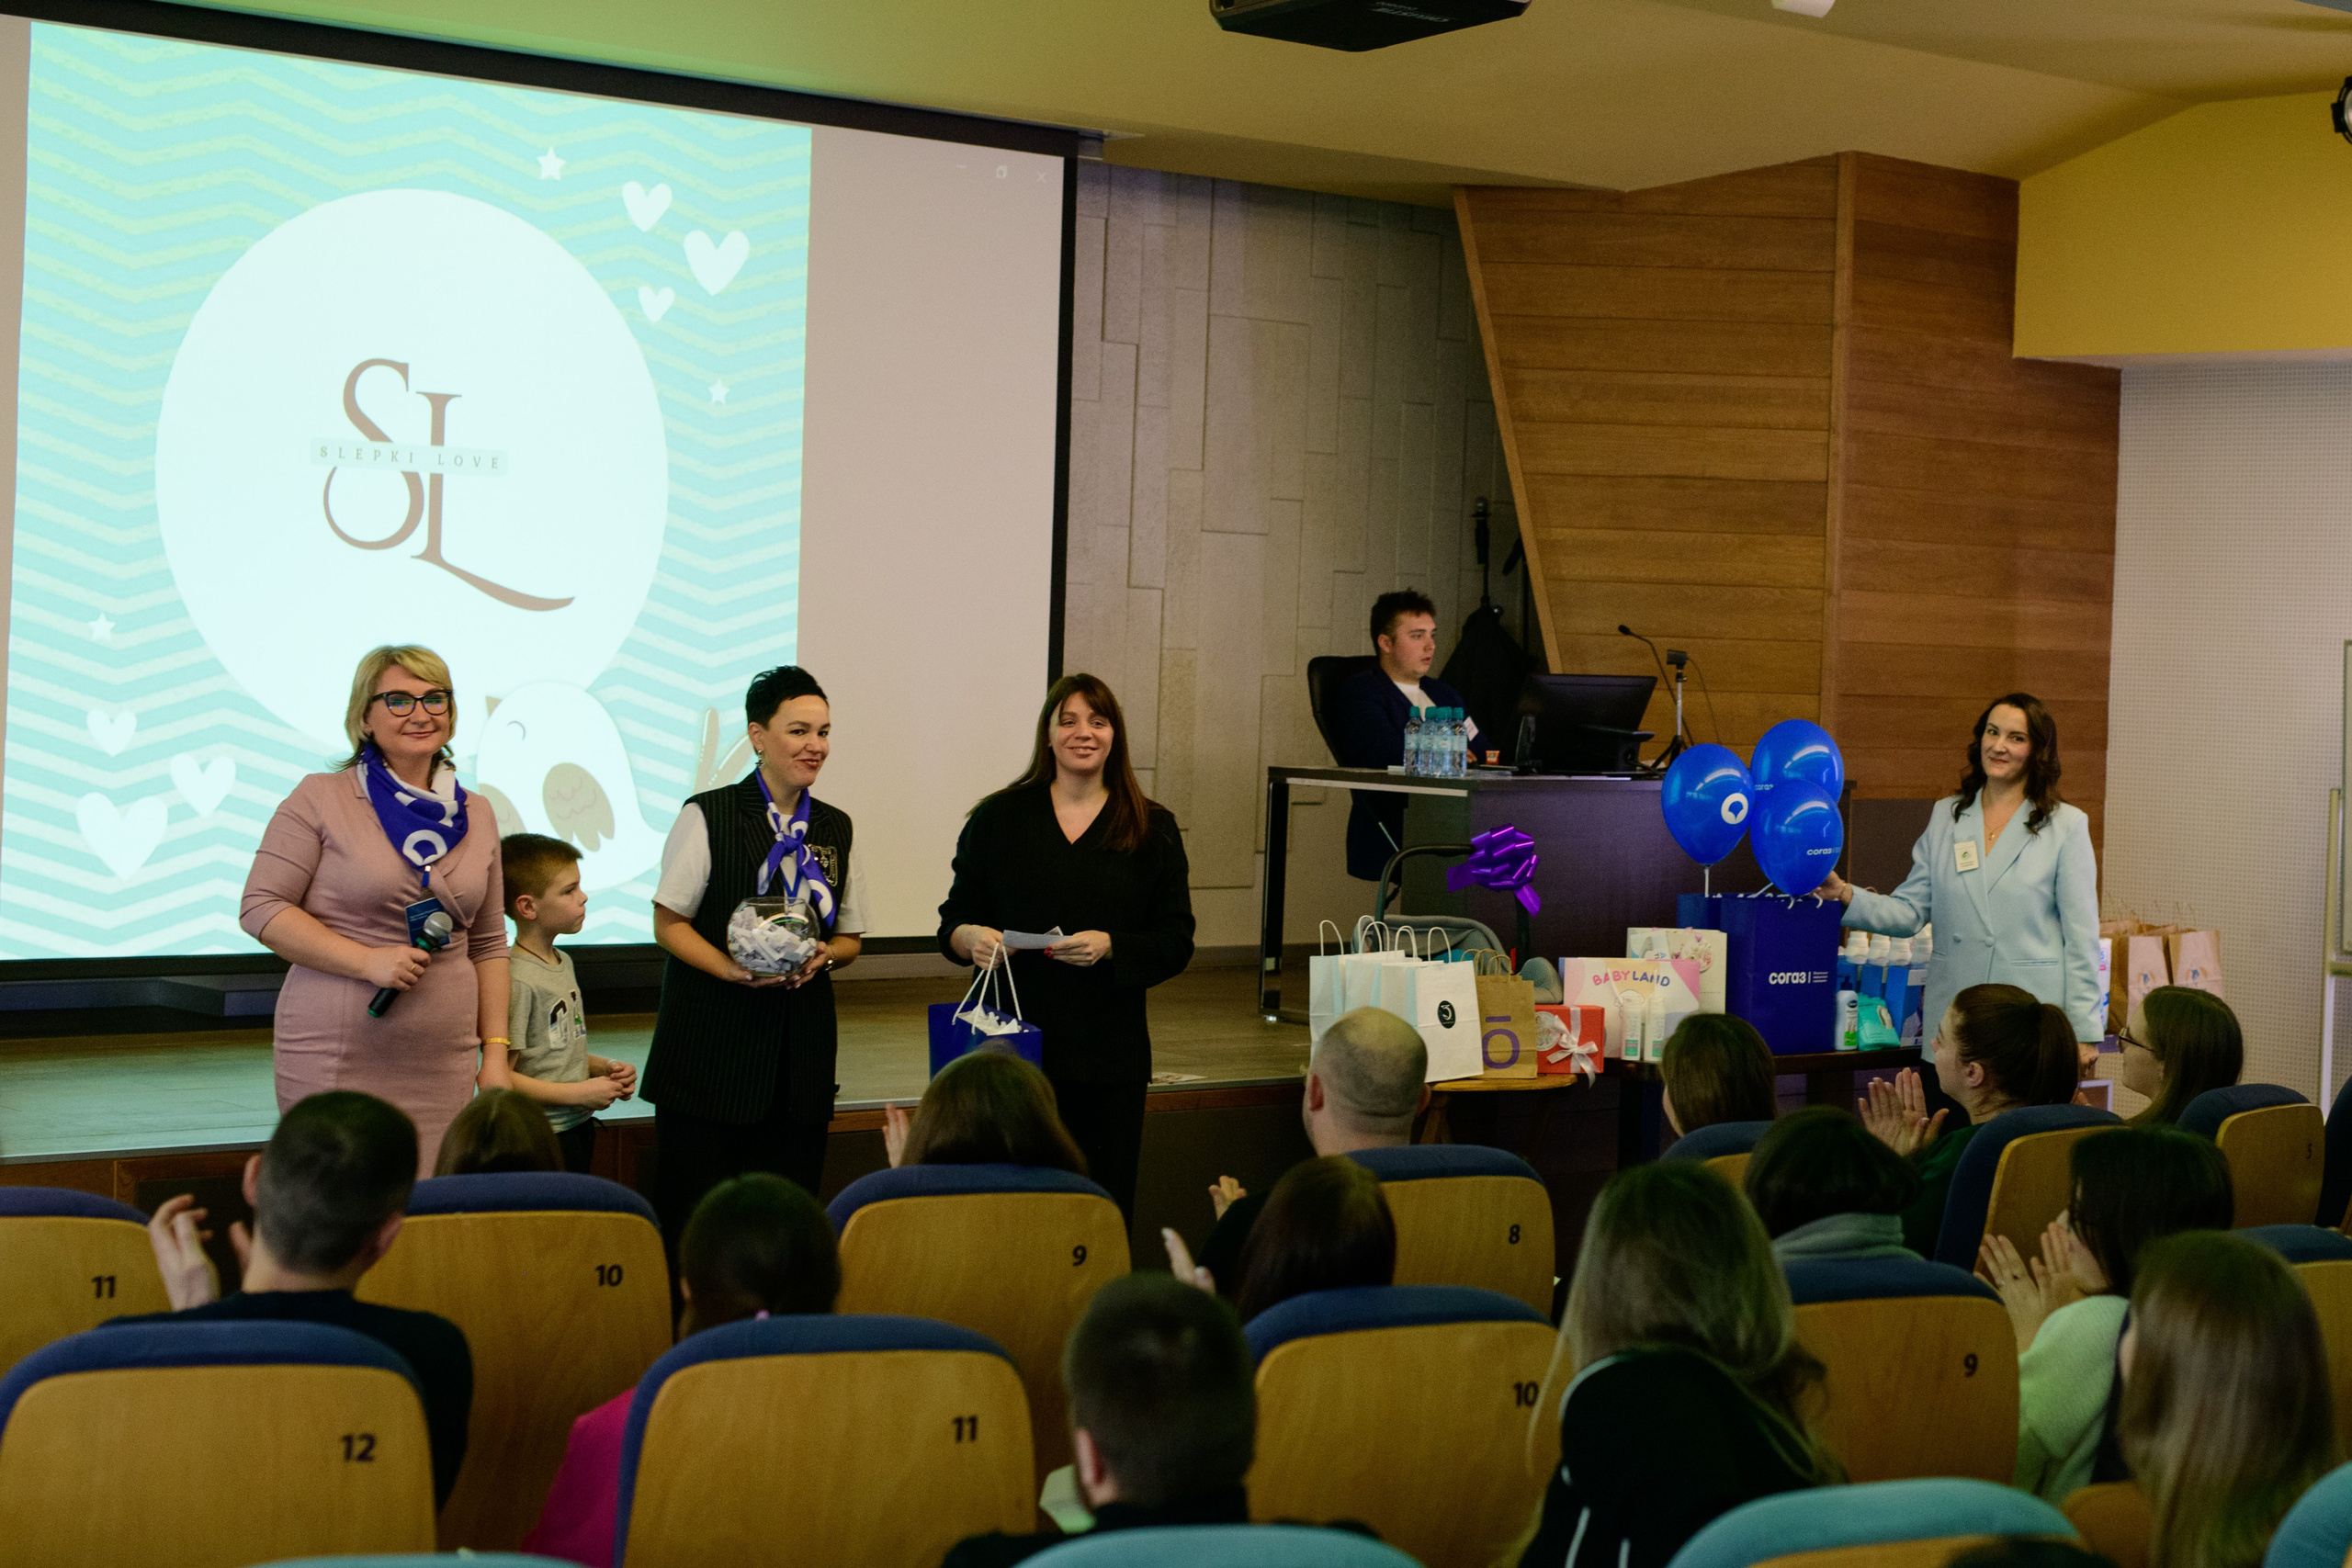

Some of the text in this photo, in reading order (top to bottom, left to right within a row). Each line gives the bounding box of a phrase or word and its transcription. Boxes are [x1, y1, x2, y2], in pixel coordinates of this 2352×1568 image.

[320, 446, 499, 469] SLEPKI LOVE
[1509, 1224, 1521, 1246] 8
[1071, 1244, 1088, 1267] 9
[91, 1275, 116, 1299] 11
[594, 1263, 624, 1288] 10
[1963, 1352, 1978, 1378] 9
[1512, 1381, 1540, 1407] 10
[952, 1415, 978, 1443] 11
[341, 1433, 377, 1462] 12
